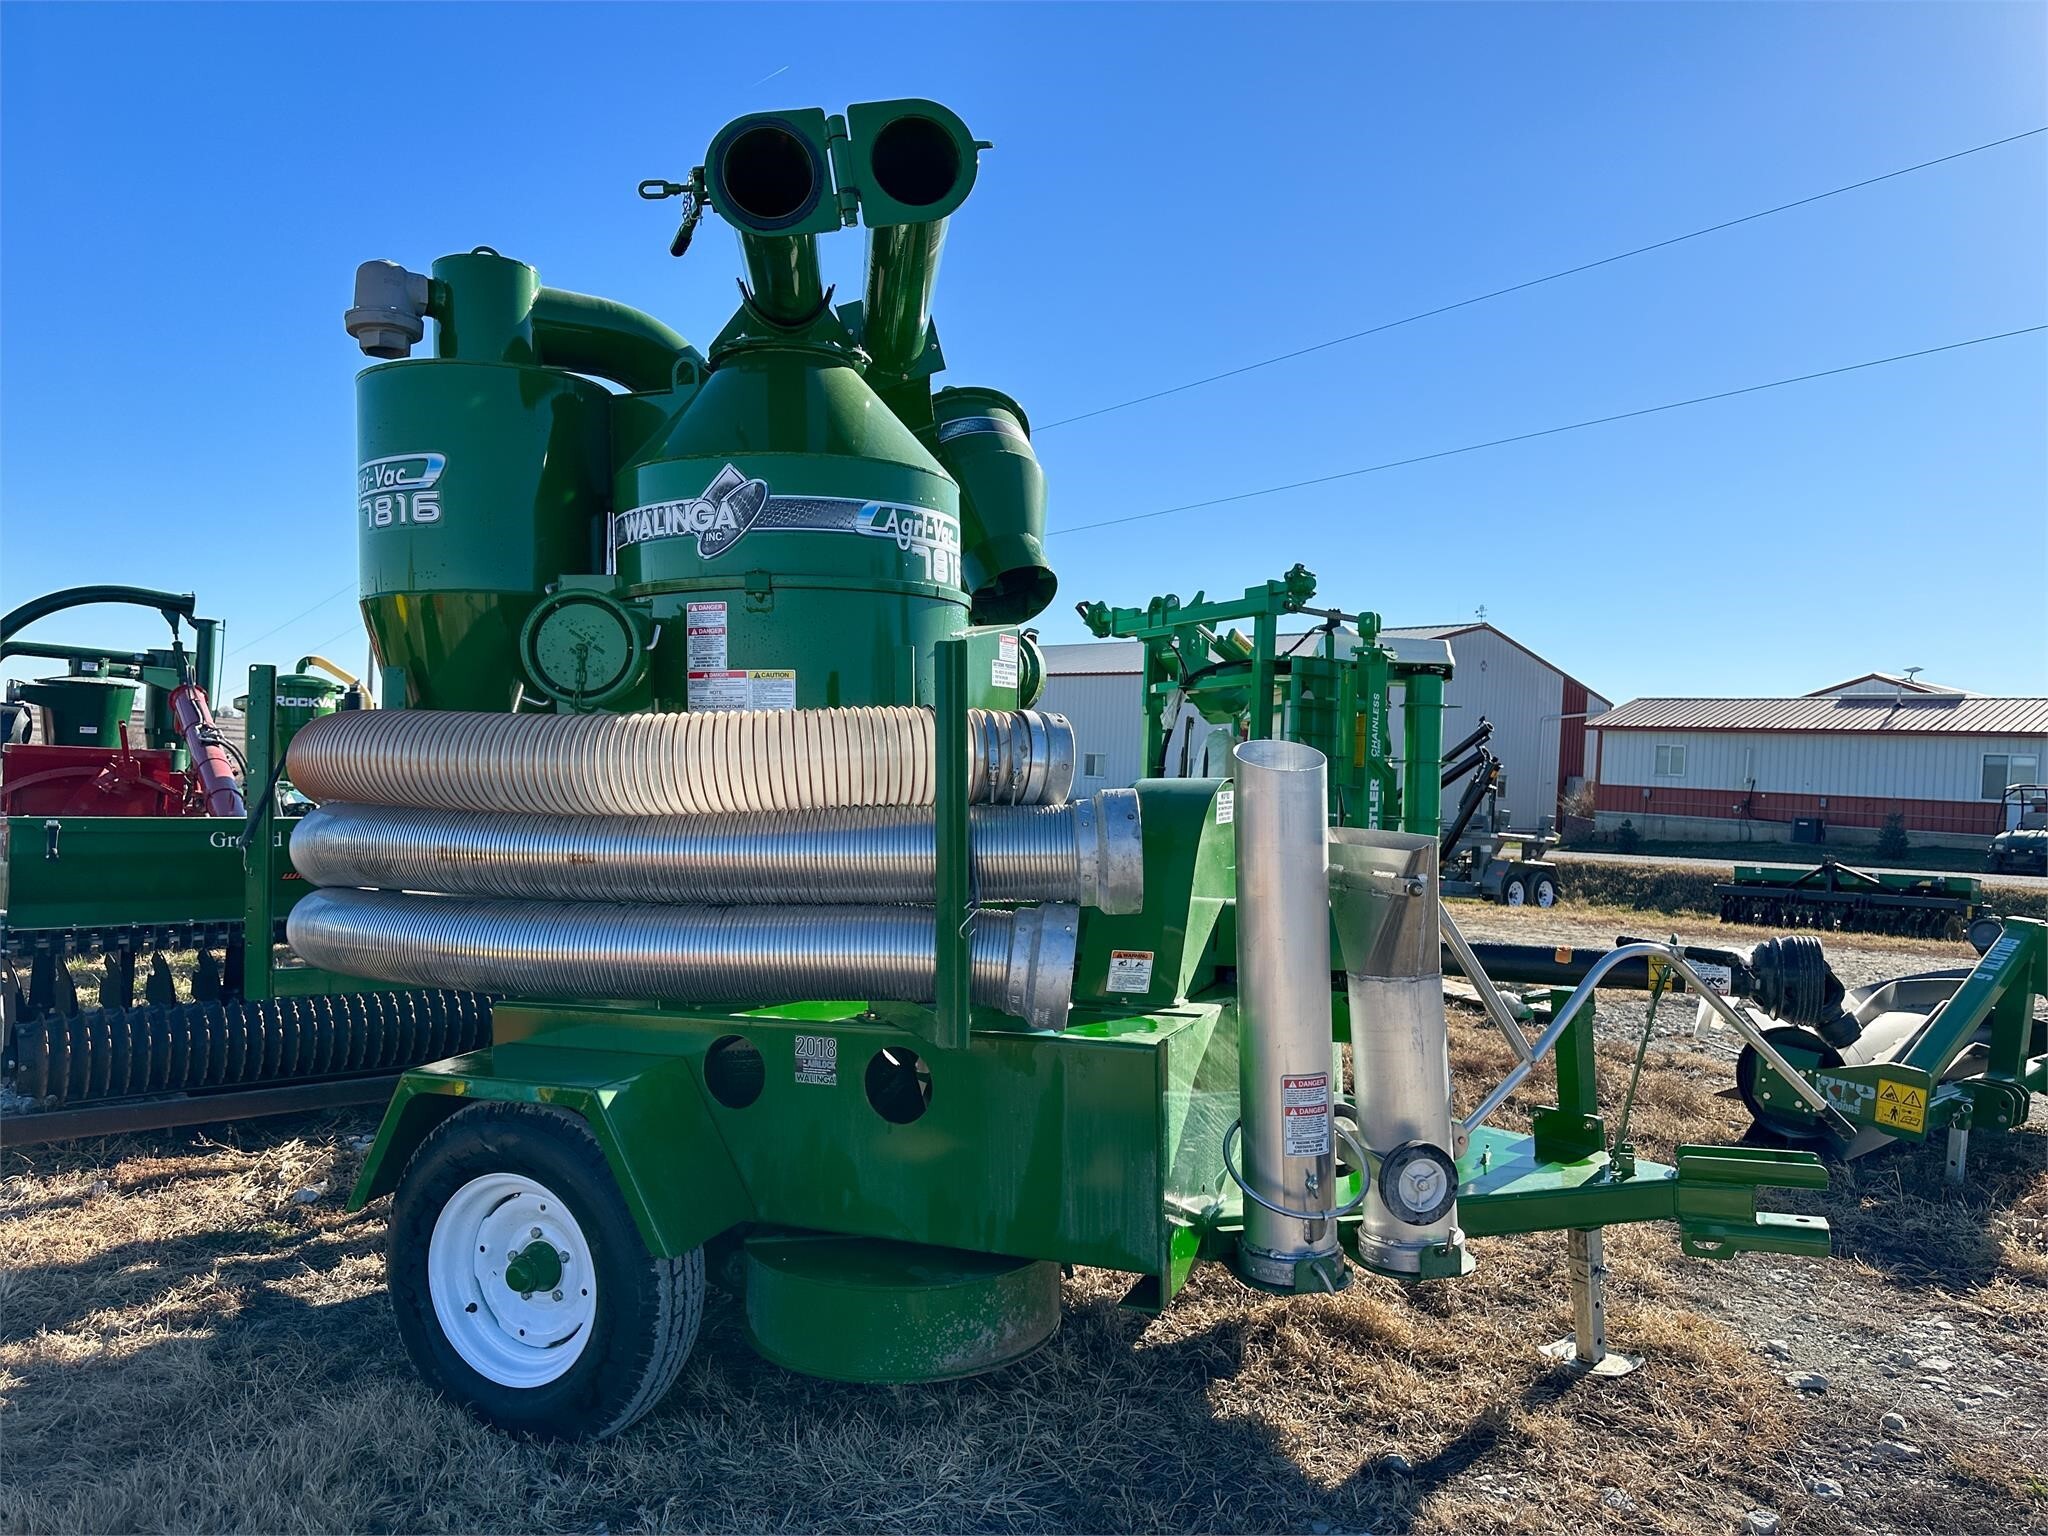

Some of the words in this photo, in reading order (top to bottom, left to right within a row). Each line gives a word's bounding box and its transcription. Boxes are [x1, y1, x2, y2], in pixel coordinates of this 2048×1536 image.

[624, 500, 738, 544] WALINGA
[874, 507, 956, 551] Agri-Vac
[705, 532, 725, 542] INC.
[698, 628, 723, 636] DANGER
[1371, 693, 1380, 757] CHAINLESS
[795, 1035, 837, 1059] 2018
[796, 1072, 835, 1084] WALINGA
[1298, 1079, 1325, 1088] DANGER
[1299, 1107, 1326, 1115] DANGER
